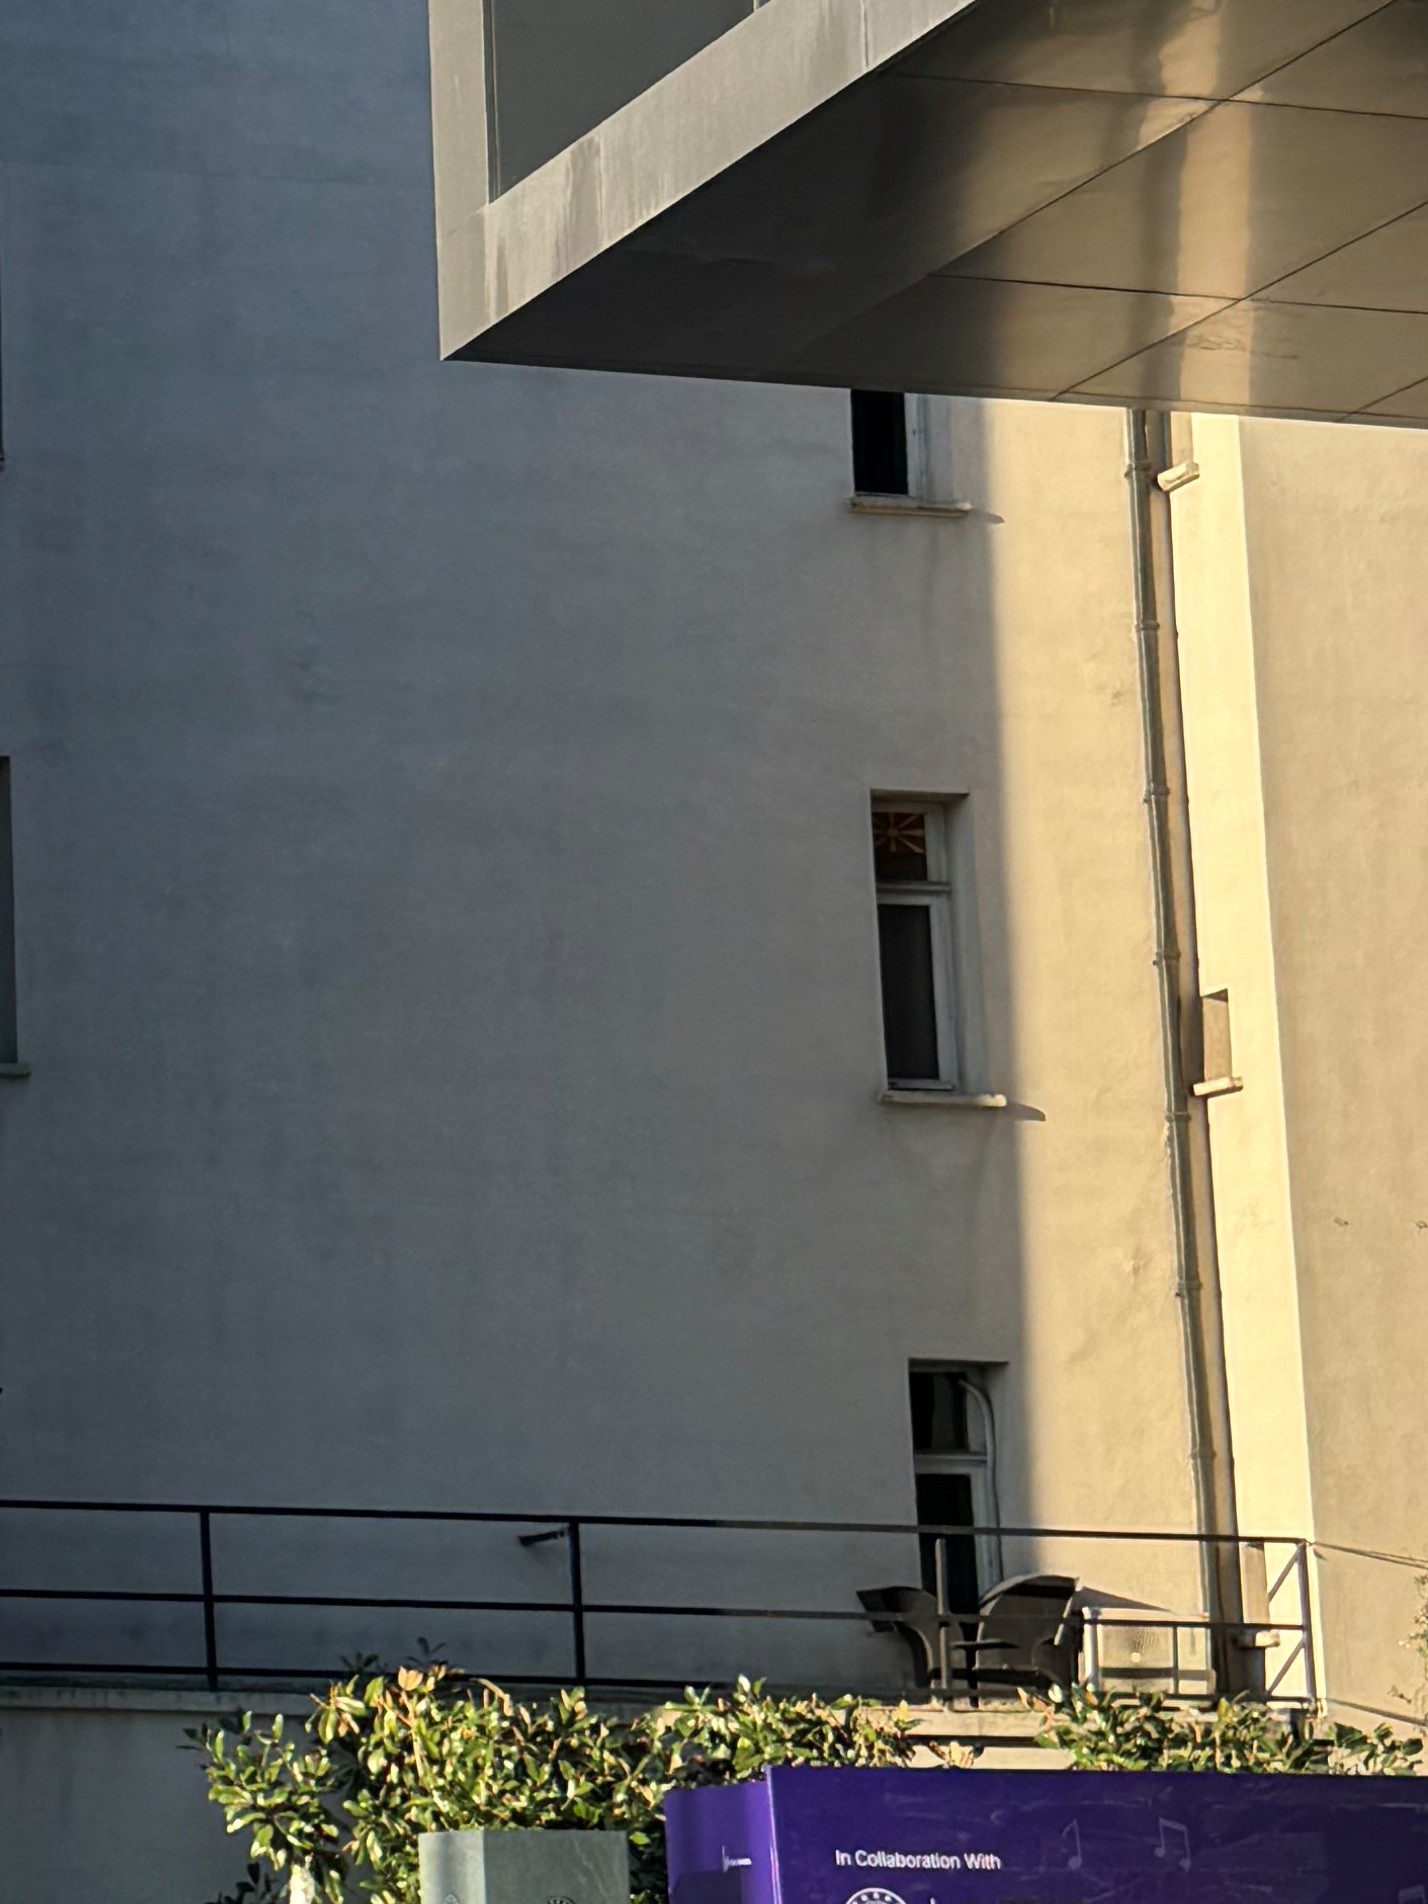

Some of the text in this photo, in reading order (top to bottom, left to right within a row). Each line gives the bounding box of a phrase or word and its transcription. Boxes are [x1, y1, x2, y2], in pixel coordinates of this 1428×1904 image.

[835, 1850, 1002, 1870] In Collaboration With
